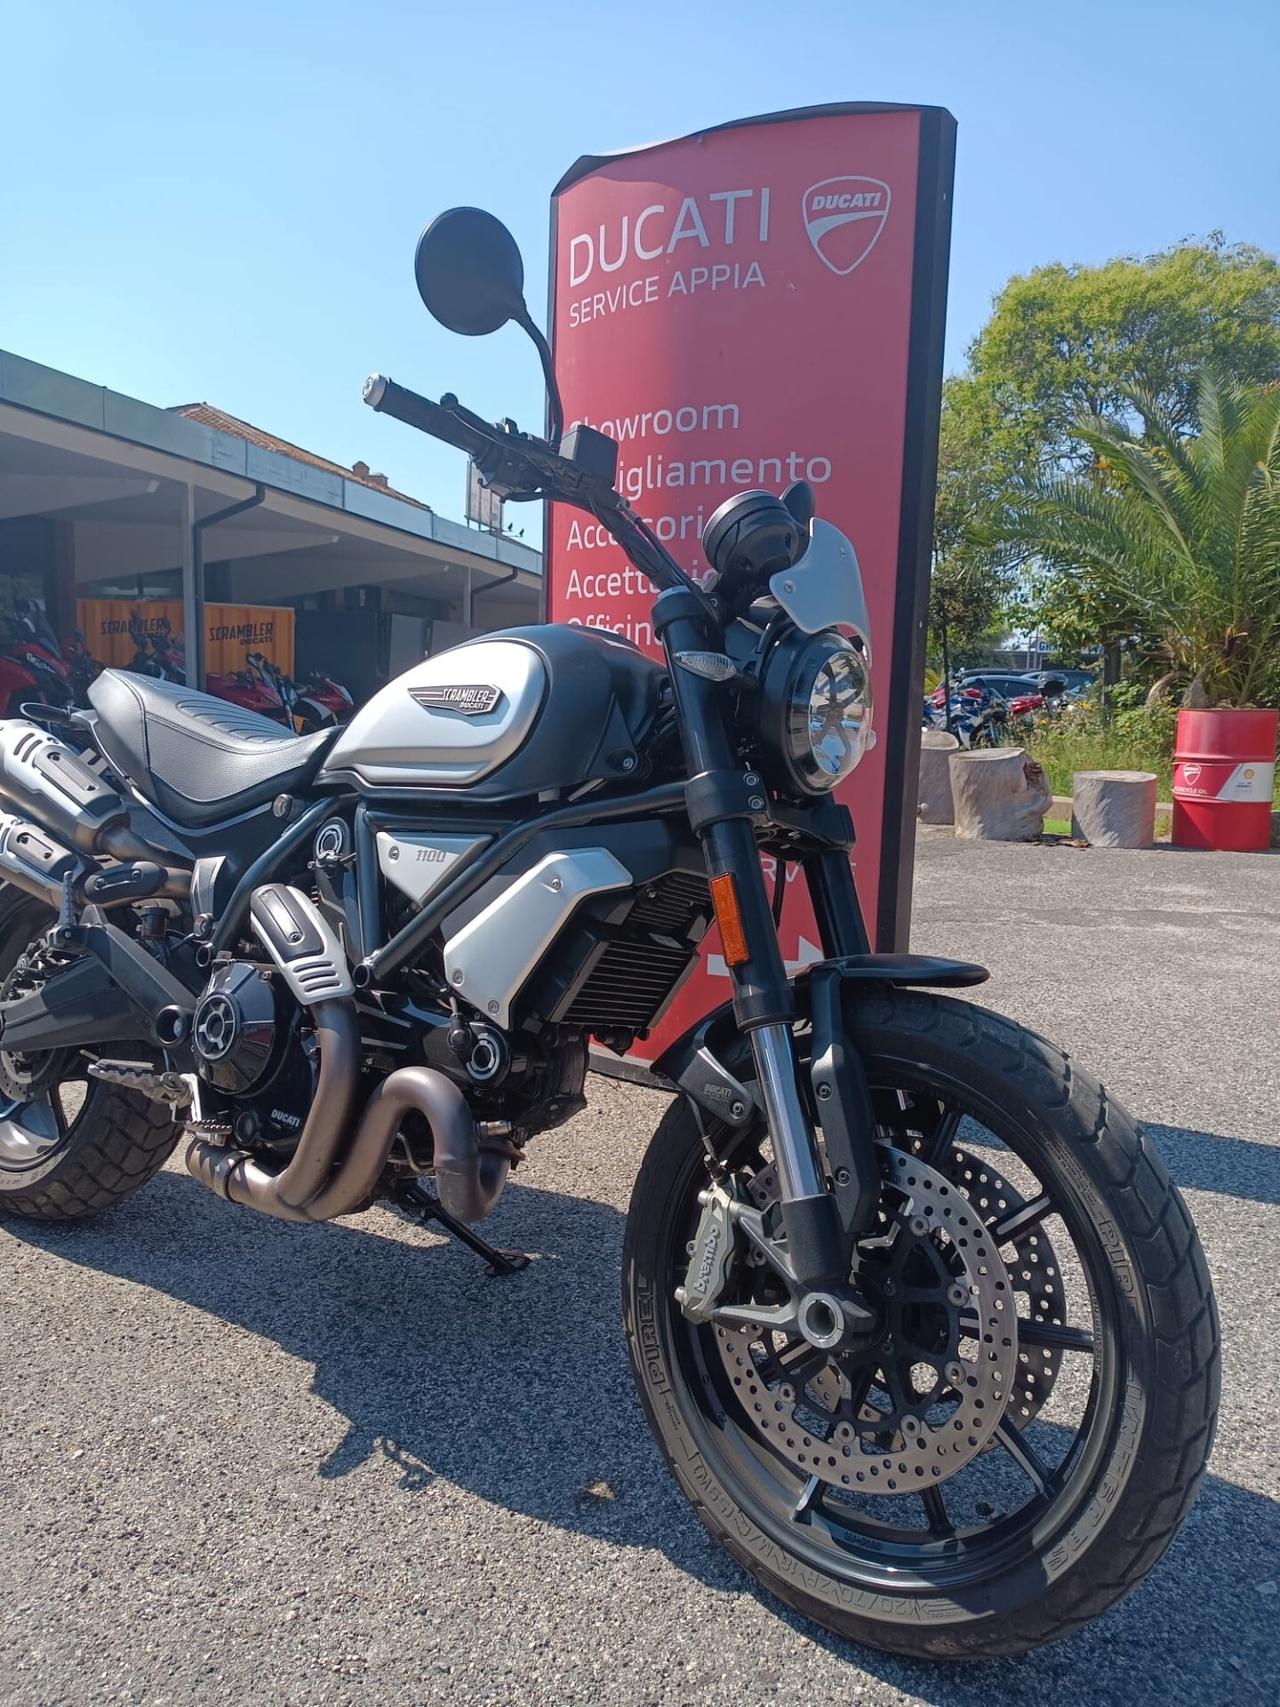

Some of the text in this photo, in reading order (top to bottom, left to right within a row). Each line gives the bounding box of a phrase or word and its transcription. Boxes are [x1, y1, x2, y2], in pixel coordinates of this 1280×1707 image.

[811, 191, 881, 211] DUCATI
[569, 187, 769, 288] DUCATI
[569, 262, 766, 328] SERVICE APPIA
[616, 451, 832, 502] igliamento
[208, 622, 274, 642] SCRAMBLER
[443, 688, 489, 703] SCRAMBLER
[459, 701, 484, 710] DUCATI
[415, 849, 447, 863] 1100
[271, 1108, 302, 1128] DUCATI
[694, 1224, 719, 1294] brembo
